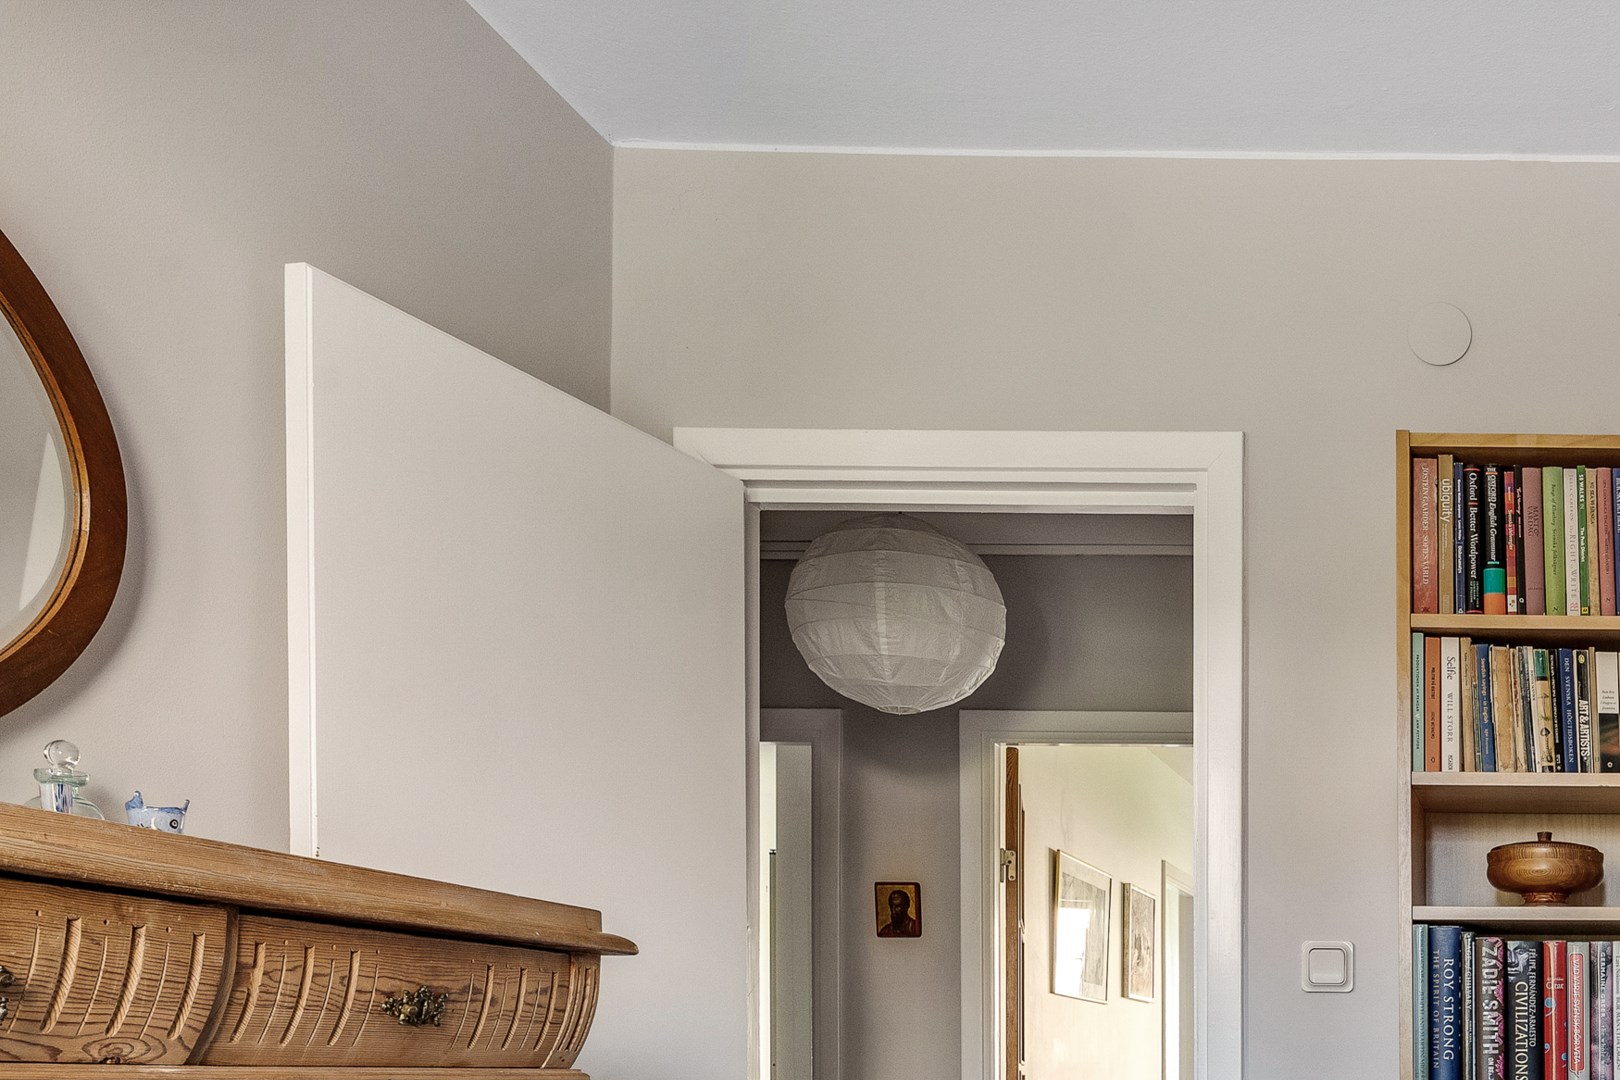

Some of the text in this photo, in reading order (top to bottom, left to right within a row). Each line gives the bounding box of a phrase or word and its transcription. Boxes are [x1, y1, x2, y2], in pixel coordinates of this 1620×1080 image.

[1440, 479, 1452, 522] ubiquity
[1468, 473, 1478, 579] Oxford Better Wordpower
[1446, 656, 1456, 680] Selfie
[1566, 709, 1574, 763] HÖGTIDSBOKEN
[1433, 1010, 1440, 1023] OF
[1443, 958, 1455, 1060] ROY STRONG
[1482, 946, 1498, 1055] ZADIE SMITH
